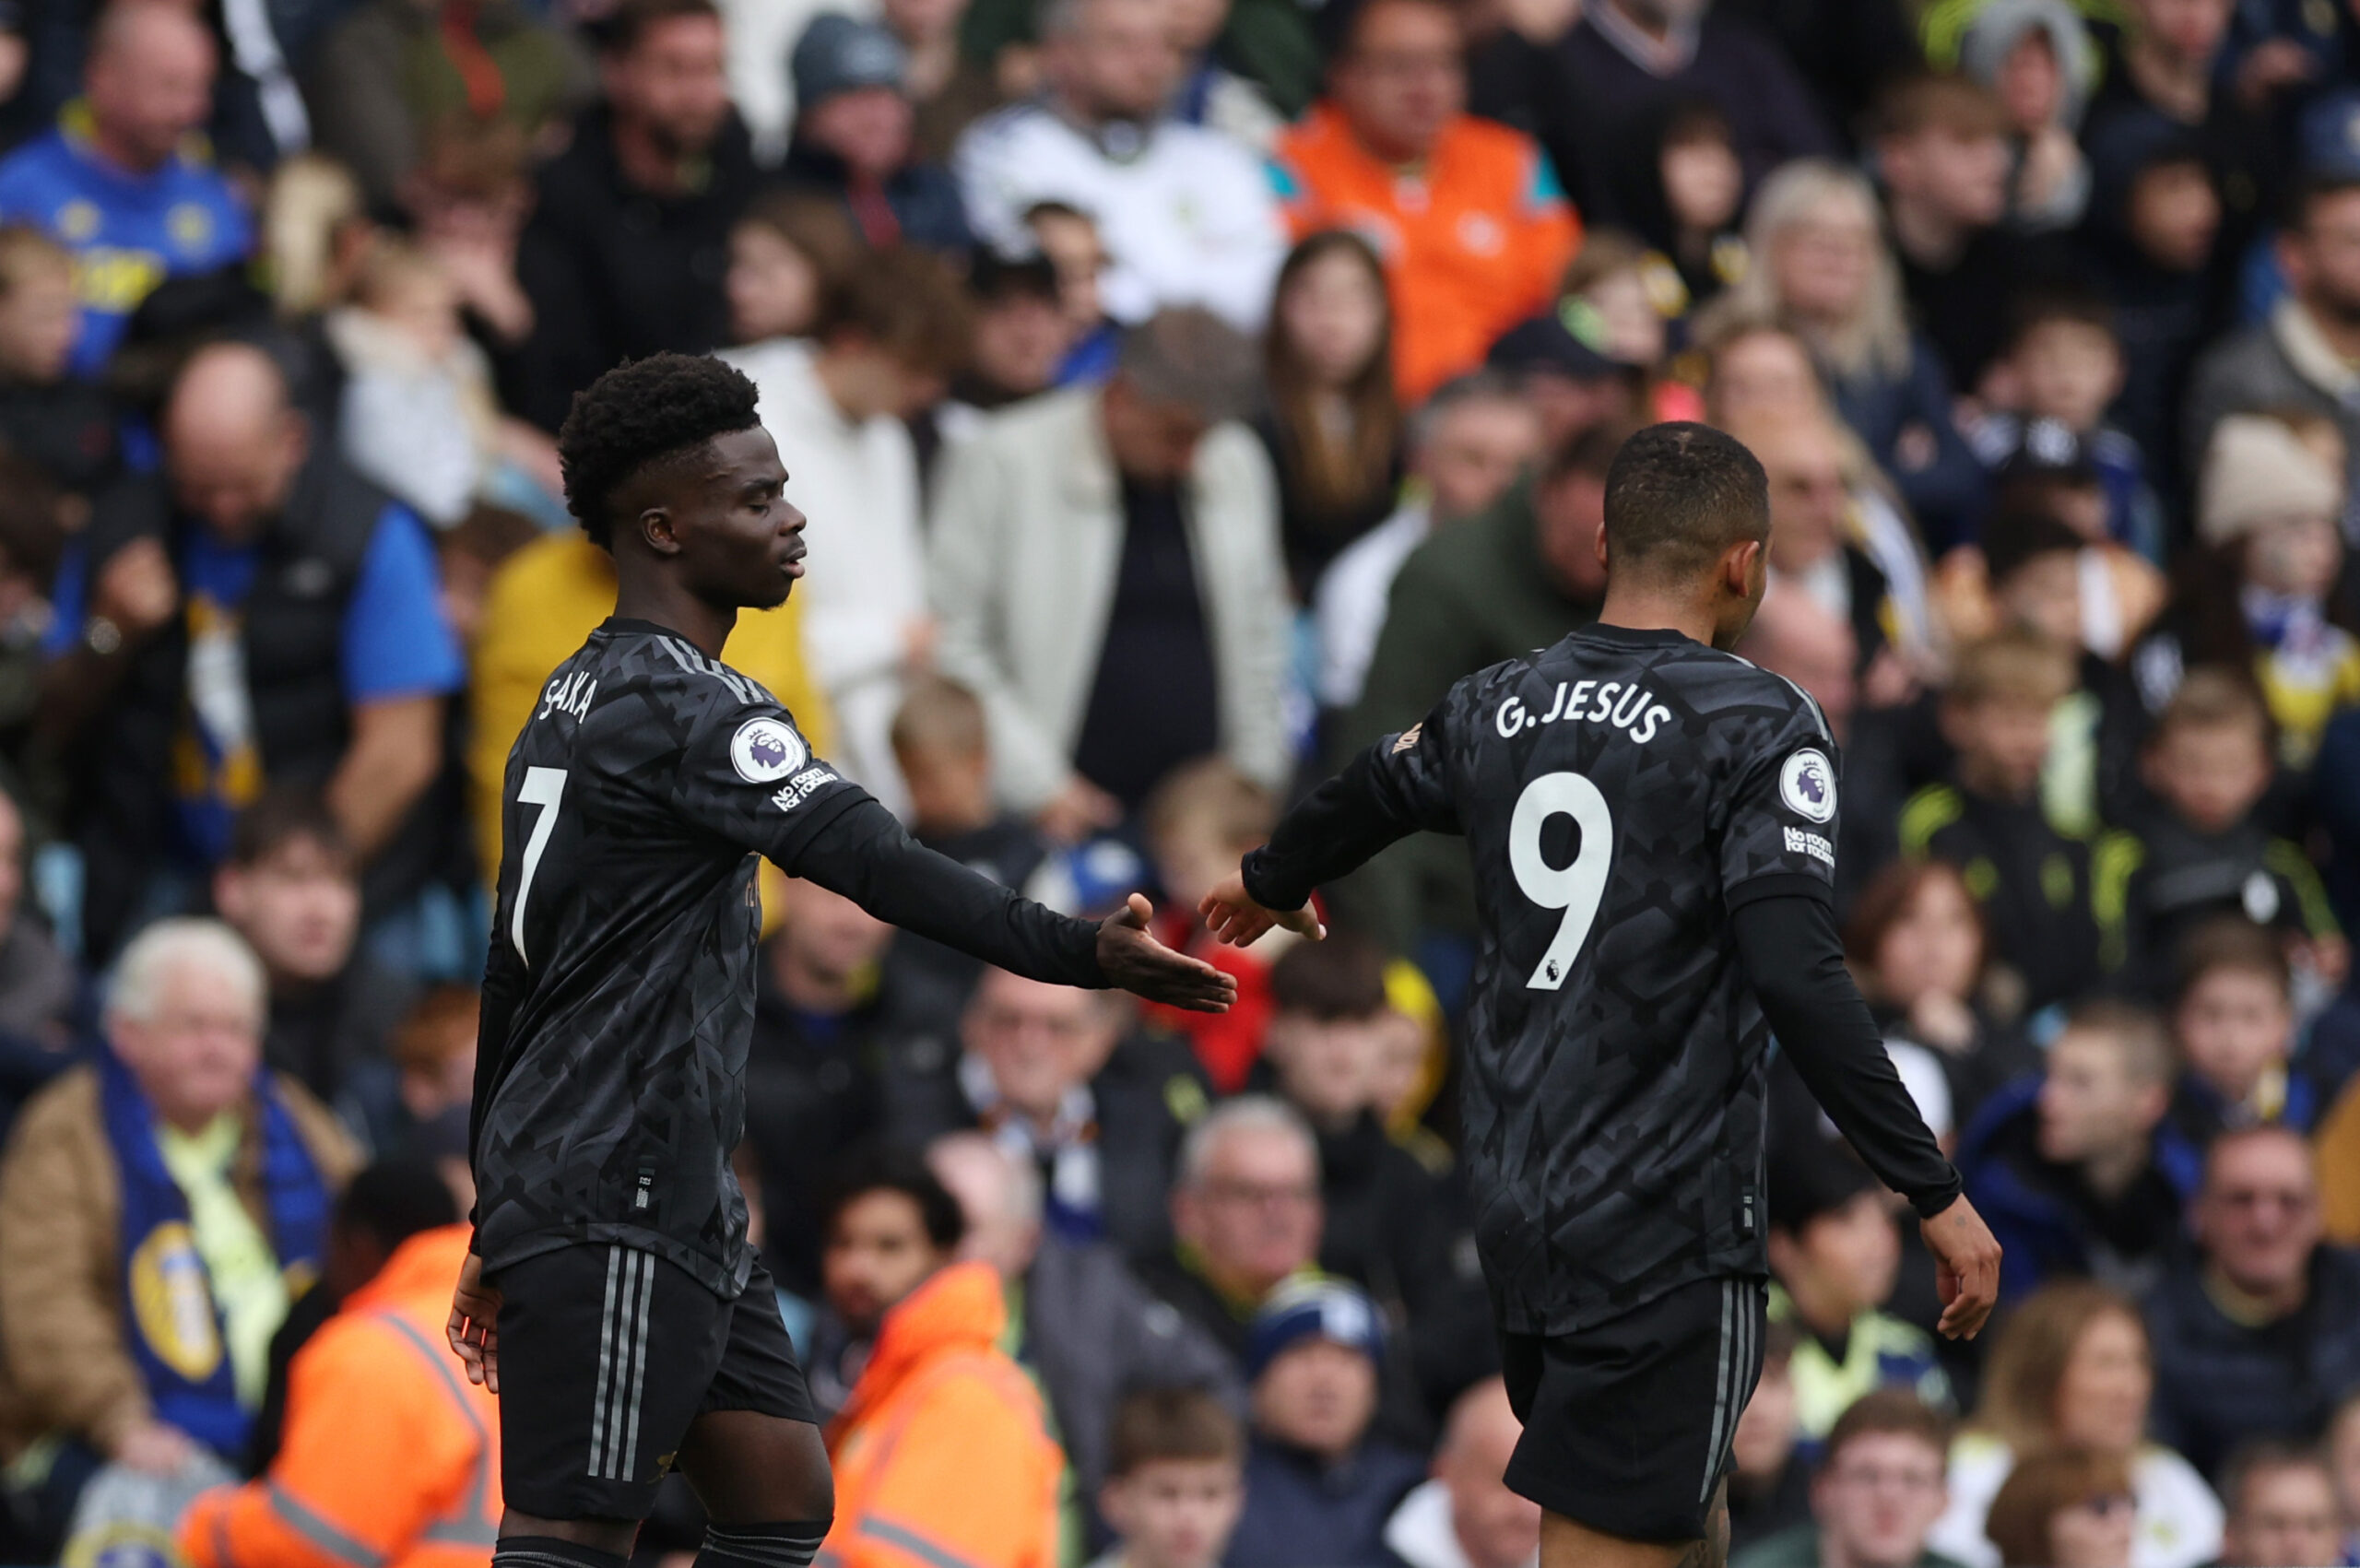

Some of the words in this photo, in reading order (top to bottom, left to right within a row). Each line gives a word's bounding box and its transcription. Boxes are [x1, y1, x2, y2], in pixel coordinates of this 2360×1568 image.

[538, 671, 597, 725] SAKA
[772, 785, 794, 806] No
[790, 767, 825, 789] room
[1783, 825, 1806, 843] No
[1805, 832, 1832, 855] room
[512, 766, 569, 972] 7
[1509, 772, 1613, 991] 9
